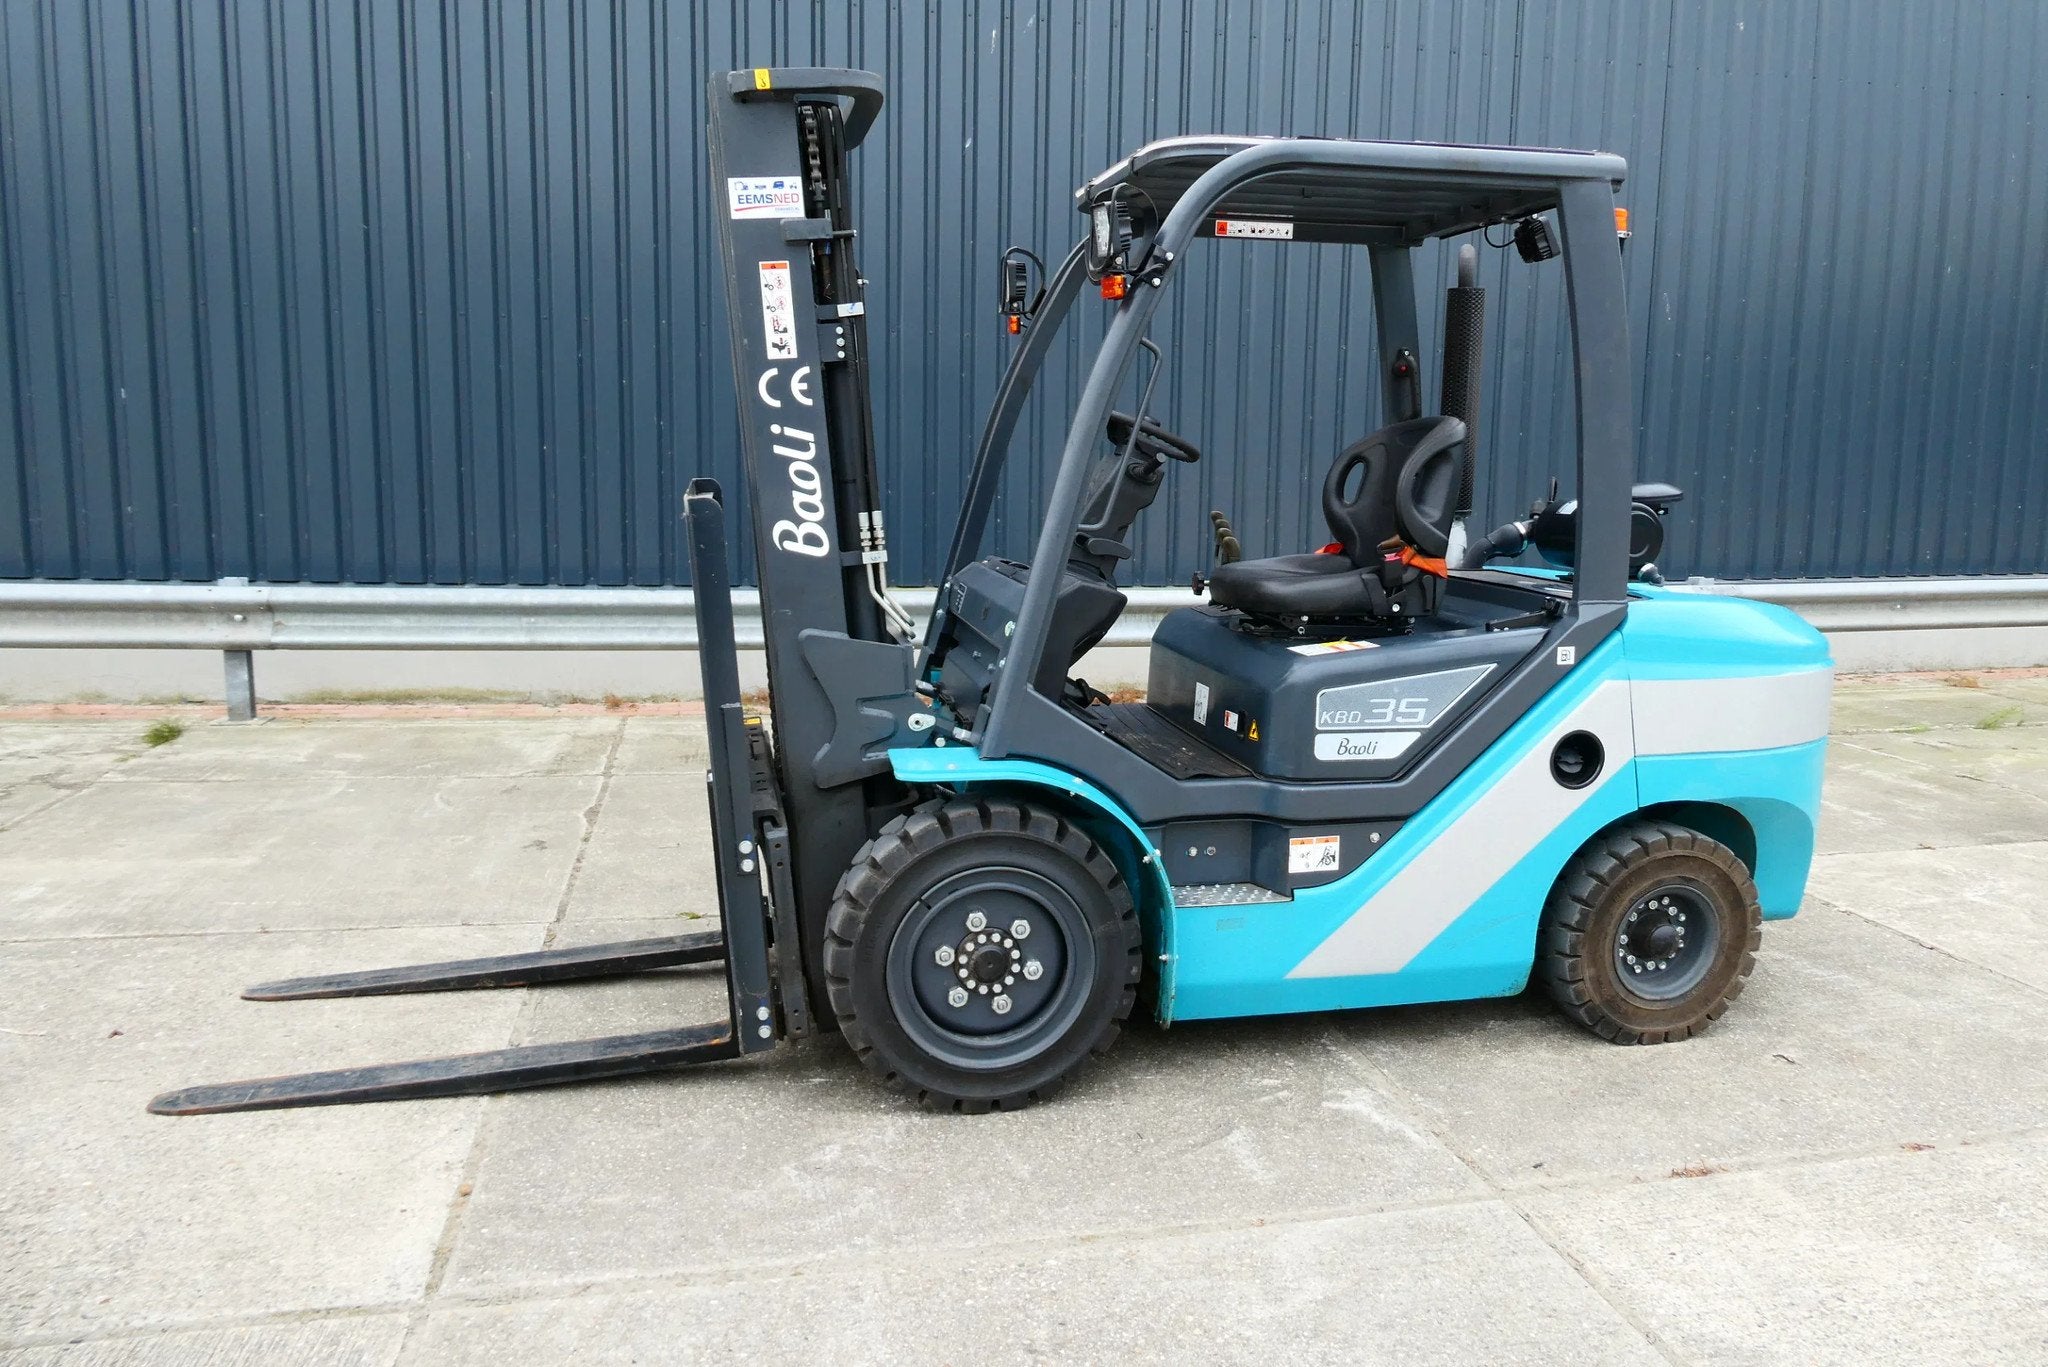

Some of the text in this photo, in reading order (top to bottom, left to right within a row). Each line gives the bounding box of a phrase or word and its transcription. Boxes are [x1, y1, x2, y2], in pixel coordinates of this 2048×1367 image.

[738, 193, 799, 204] EEMSNED
[770, 423, 830, 558] Baoli
[1320, 697, 1429, 724] KBD 35
[1337, 737, 1378, 756] Baoli
